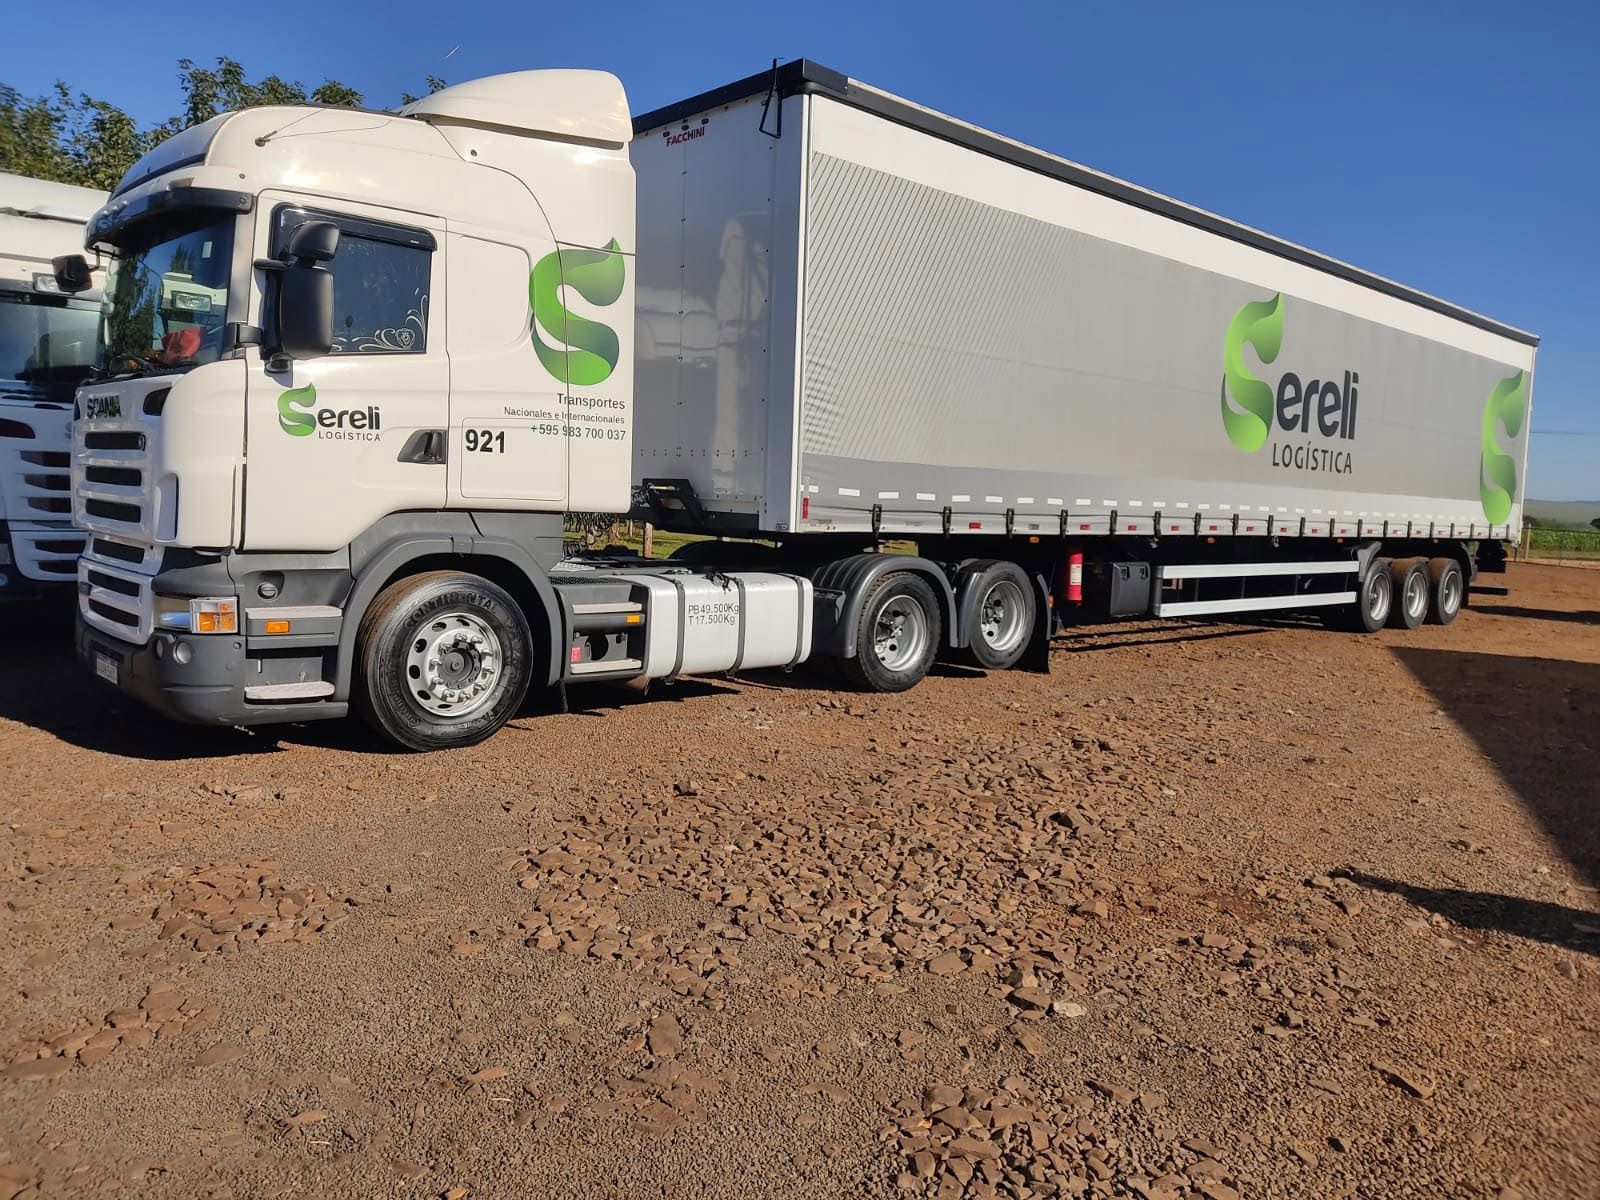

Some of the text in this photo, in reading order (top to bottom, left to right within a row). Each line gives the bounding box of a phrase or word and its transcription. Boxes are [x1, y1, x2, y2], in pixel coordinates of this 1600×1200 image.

[666, 126, 705, 147] FACCHINI
[87, 395, 121, 418] SCANIA
[277, 382, 380, 437] Sereli
[556, 392, 625, 410] Transportes
[504, 406, 552, 419] Nacionales
[561, 411, 625, 424] Internacionales
[318, 430, 381, 442] LOGÍSTICA
[465, 429, 506, 454] 921
[530, 423, 626, 441] +595 983 700 037
[1272, 441, 1353, 475] LOGÍSTICA
